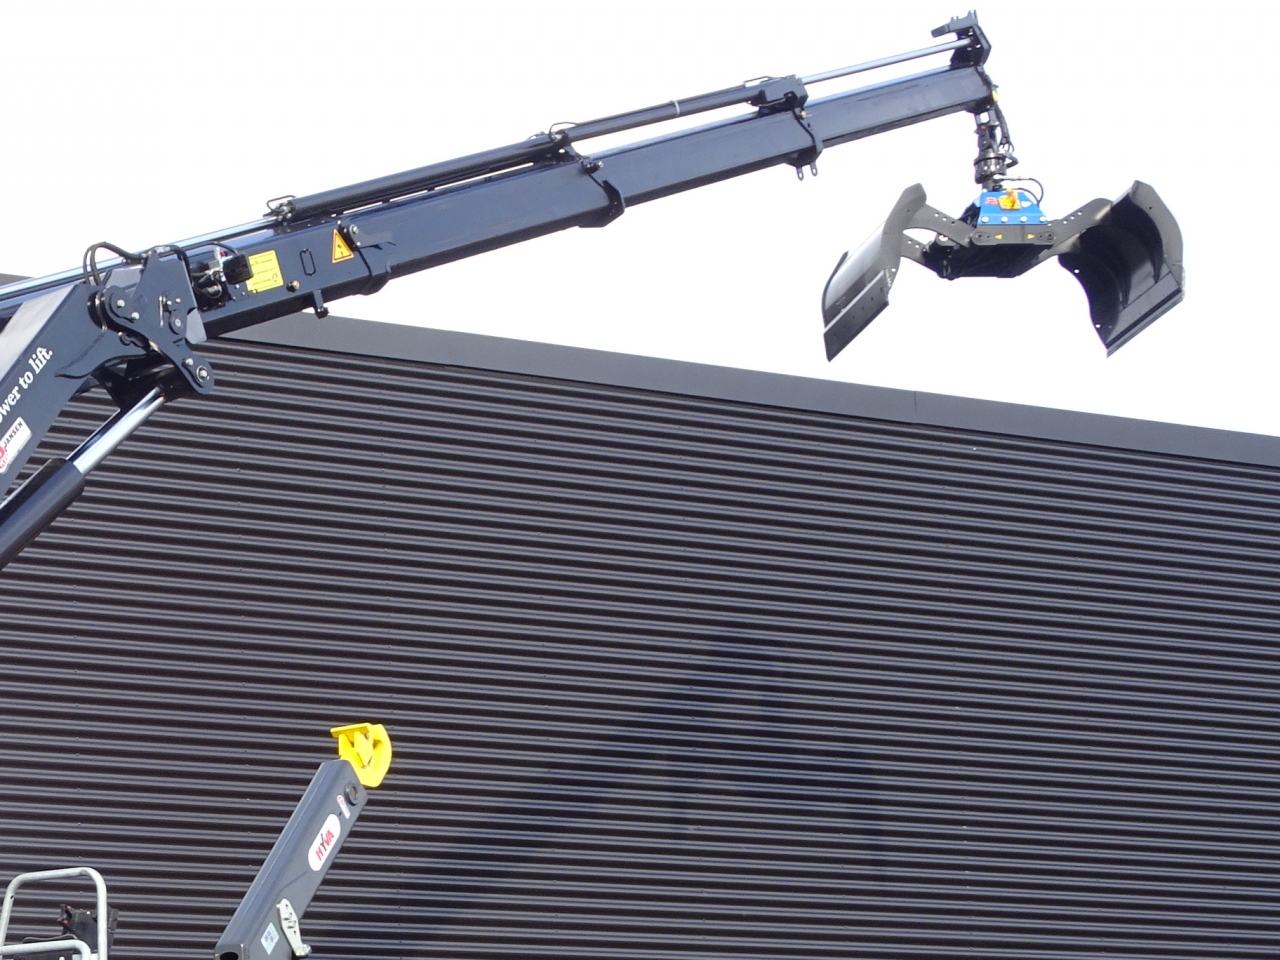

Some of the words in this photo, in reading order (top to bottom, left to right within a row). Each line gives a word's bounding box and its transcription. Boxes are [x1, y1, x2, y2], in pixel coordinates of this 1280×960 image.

[18, 371, 34, 389] to
[28, 347, 53, 374] lift.
[4, 420, 24, 448] JANSEN
[315, 829, 335, 861] HYVA
